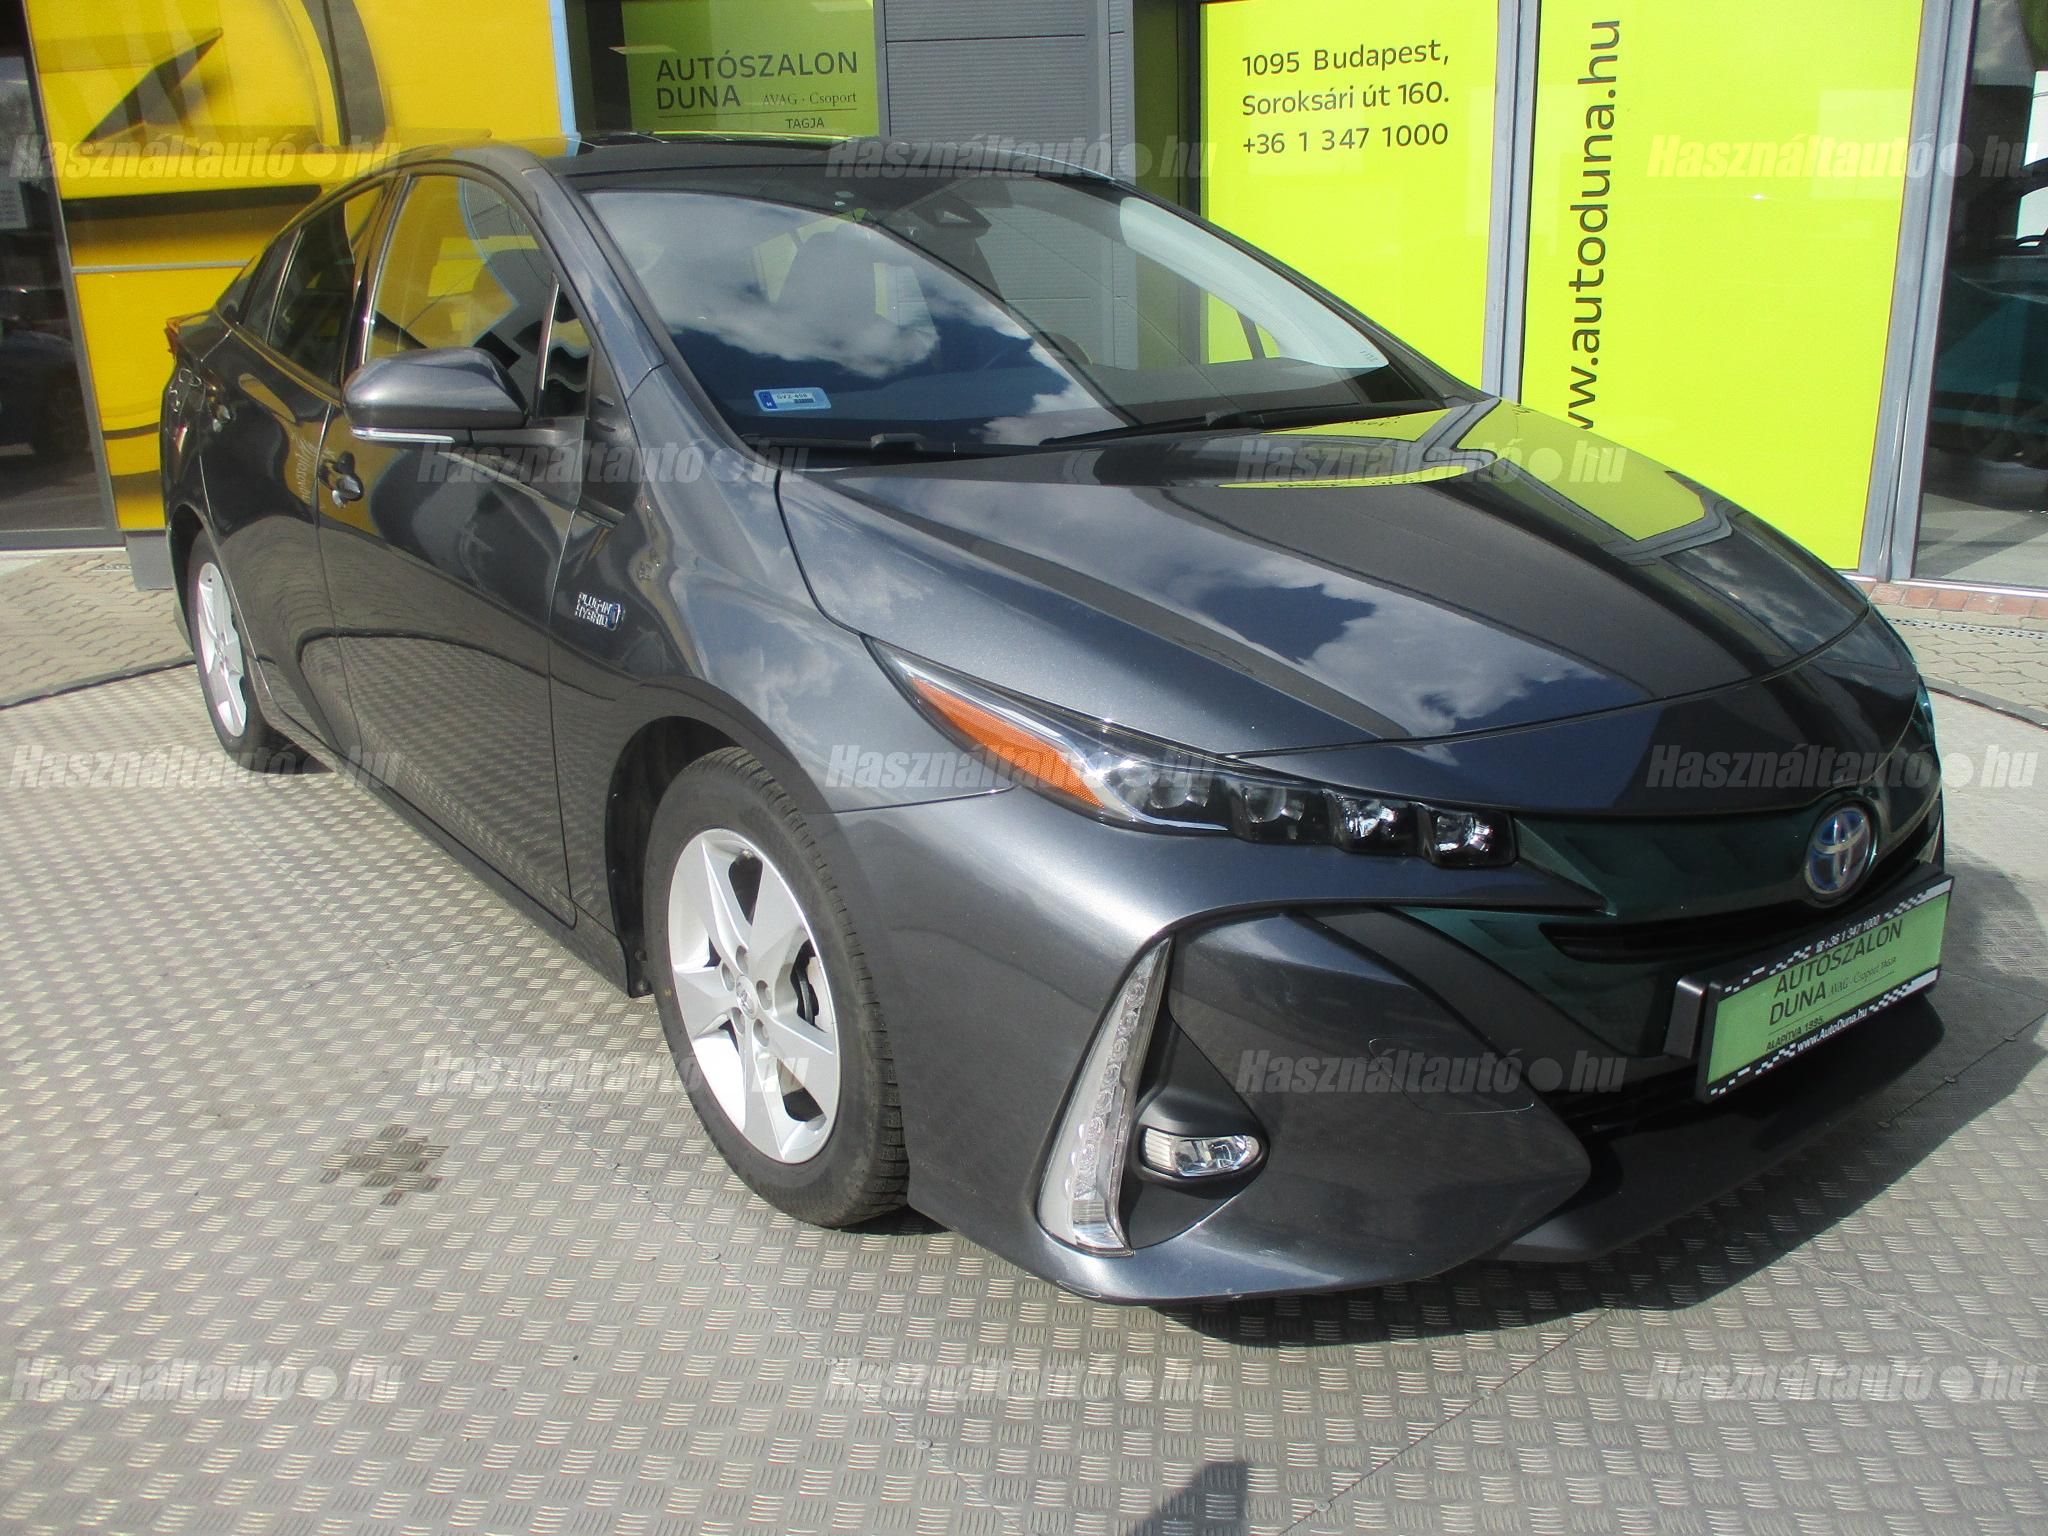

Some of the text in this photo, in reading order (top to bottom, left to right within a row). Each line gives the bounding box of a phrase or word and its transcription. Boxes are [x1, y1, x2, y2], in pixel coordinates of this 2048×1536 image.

[656, 50, 858, 82] AUTÓSZALON
[1242, 39, 1449, 76] 1095 Budapest,
[656, 84, 857, 110] DUNA AVAG Csoport
[1242, 81, 1449, 116] Soroksári út 160.
[785, 117, 825, 129] TAGJA
[1243, 122, 1449, 154] +36 1 347 1000
[1769, 981, 1826, 1026] DUNA
